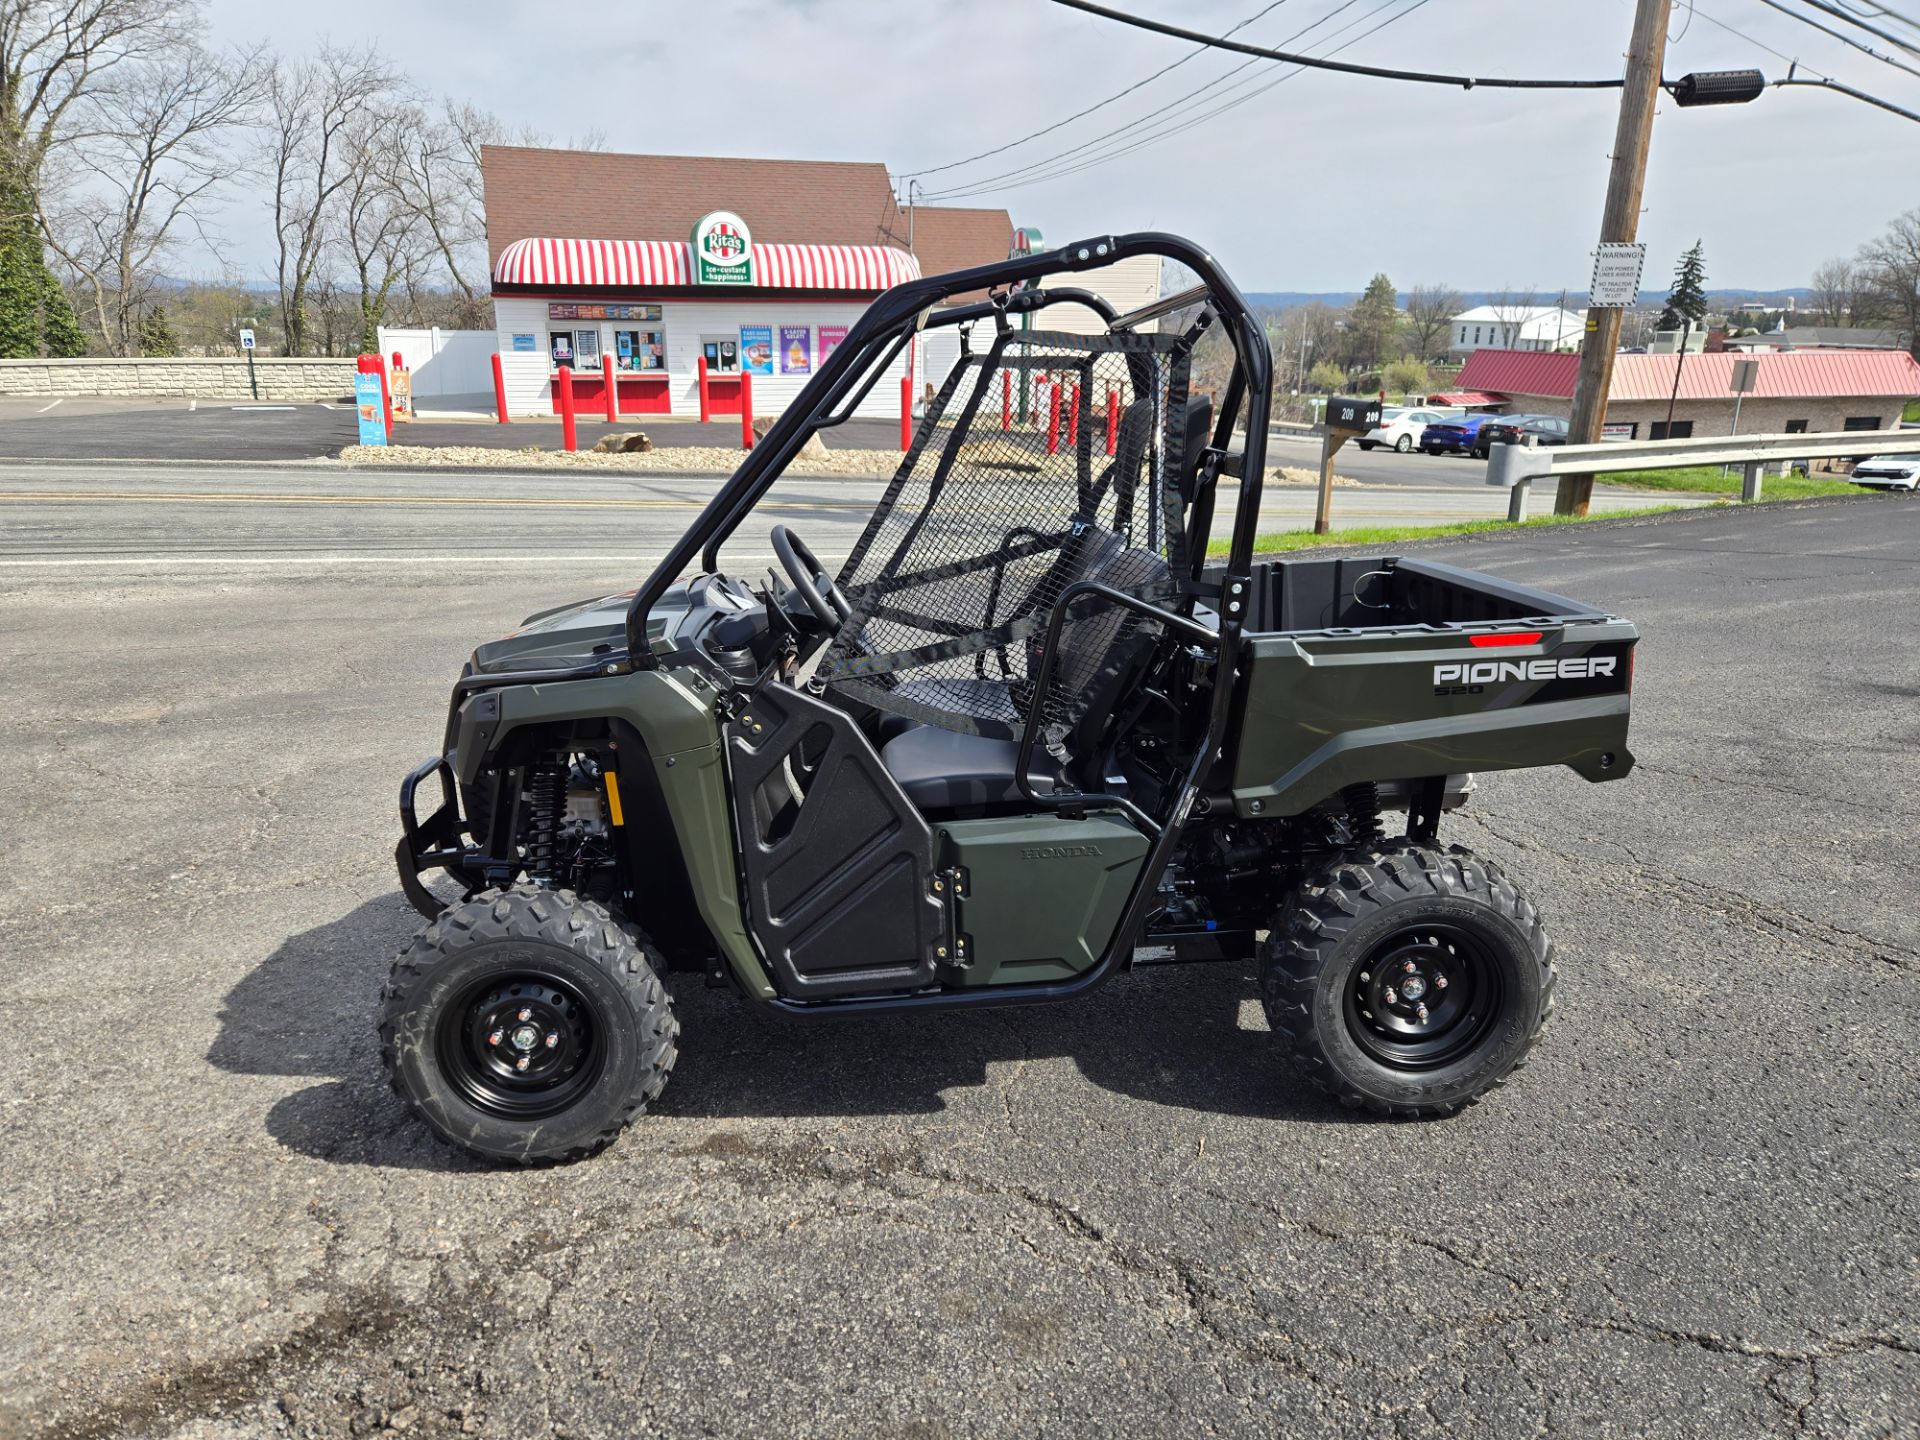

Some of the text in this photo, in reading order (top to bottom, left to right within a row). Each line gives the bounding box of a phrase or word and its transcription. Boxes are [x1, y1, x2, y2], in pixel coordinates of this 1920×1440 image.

[708, 233, 742, 250] Rita's
[1602, 251, 1640, 259] WARNING!
[720, 266, 746, 274] custard
[1341, 407, 1354, 420] 209
[1365, 411, 1379, 422] 209
[1433, 656, 1616, 685] PIONEER
[1434, 685, 1484, 696] 520
[1021, 845, 1103, 860] HONDA
